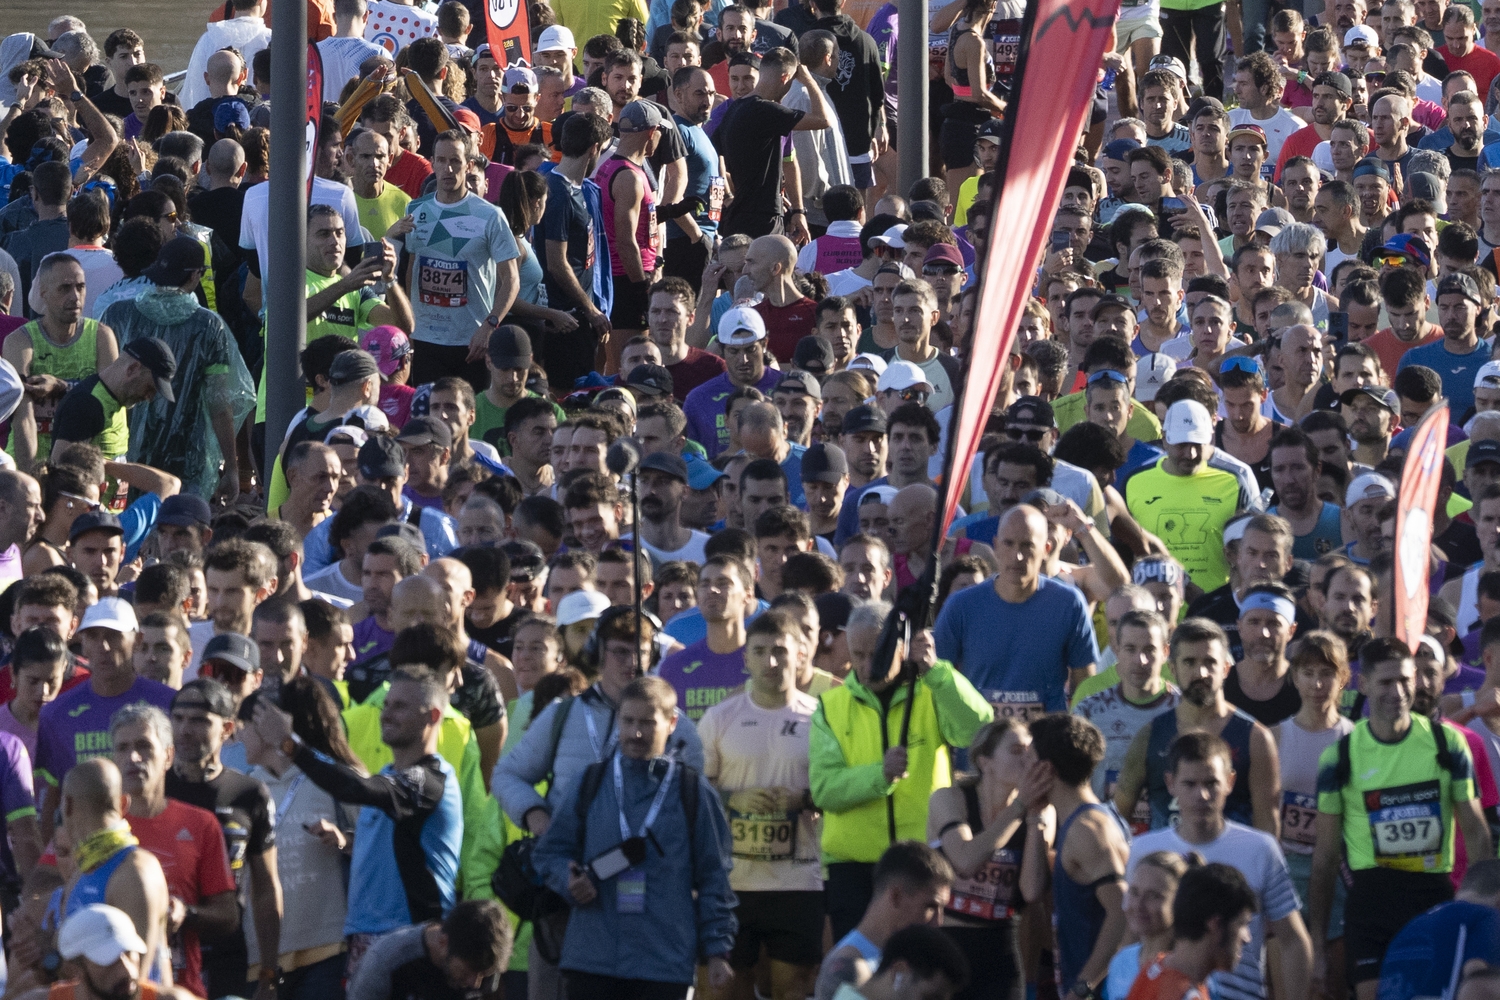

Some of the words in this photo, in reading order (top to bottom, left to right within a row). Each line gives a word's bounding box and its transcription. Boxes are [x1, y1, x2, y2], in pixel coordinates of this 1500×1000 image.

[423, 268, 463, 286] 3874
[685, 687, 728, 707] BEHO
[1413, 788, 1439, 801] sport
[1287, 809, 1317, 830] 37
[733, 821, 790, 843] 3190
[1384, 820, 1431, 843] 397
